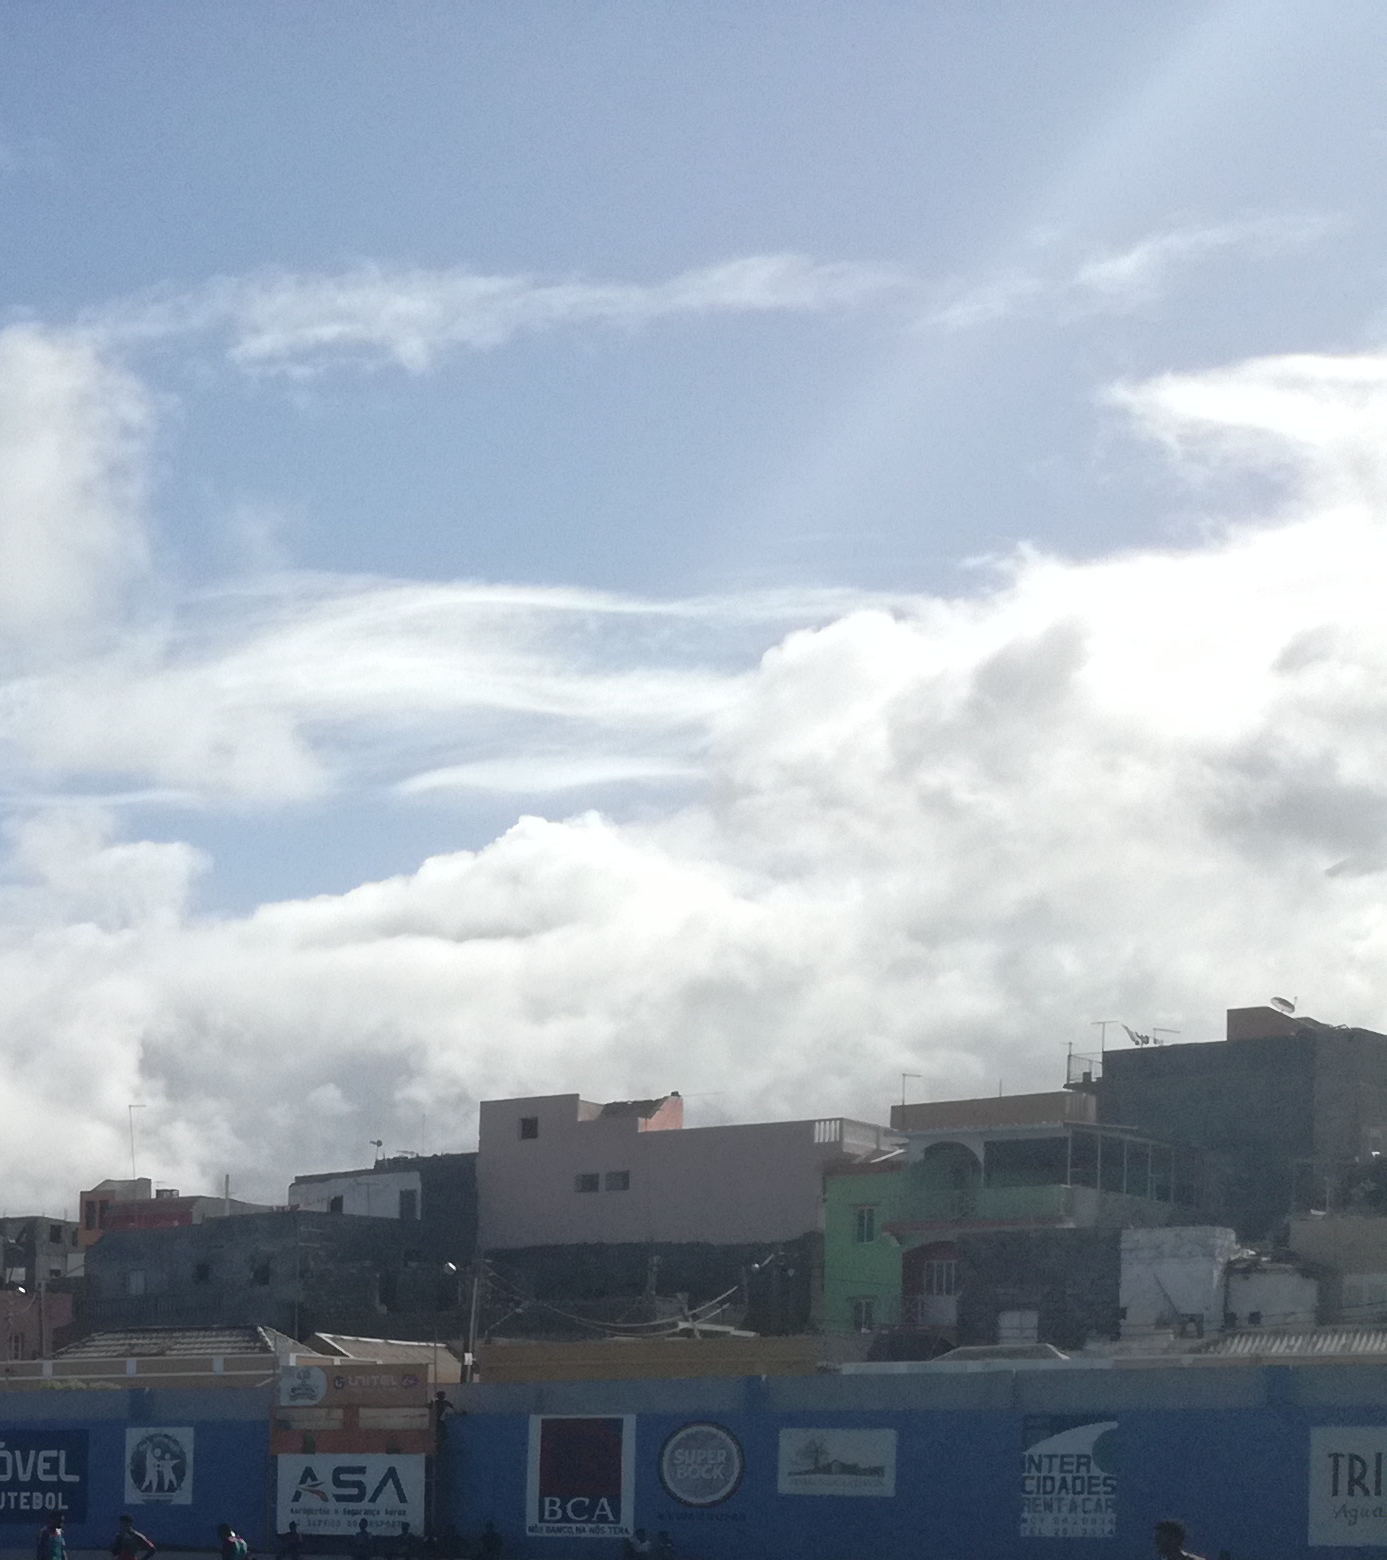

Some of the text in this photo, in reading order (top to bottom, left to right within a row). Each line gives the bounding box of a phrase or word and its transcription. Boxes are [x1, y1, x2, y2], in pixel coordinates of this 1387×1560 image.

[348, 1375, 397, 1386] UNITEL
[673, 1448, 727, 1464] SUPER
[1022, 1454, 1092, 1474] INTER
[676, 1464, 725, 1479] BOCK
[292, 1466, 408, 1503] ASA
[1021, 1475, 1117, 1495] CIDADES
[543, 1497, 616, 1521] BCA
